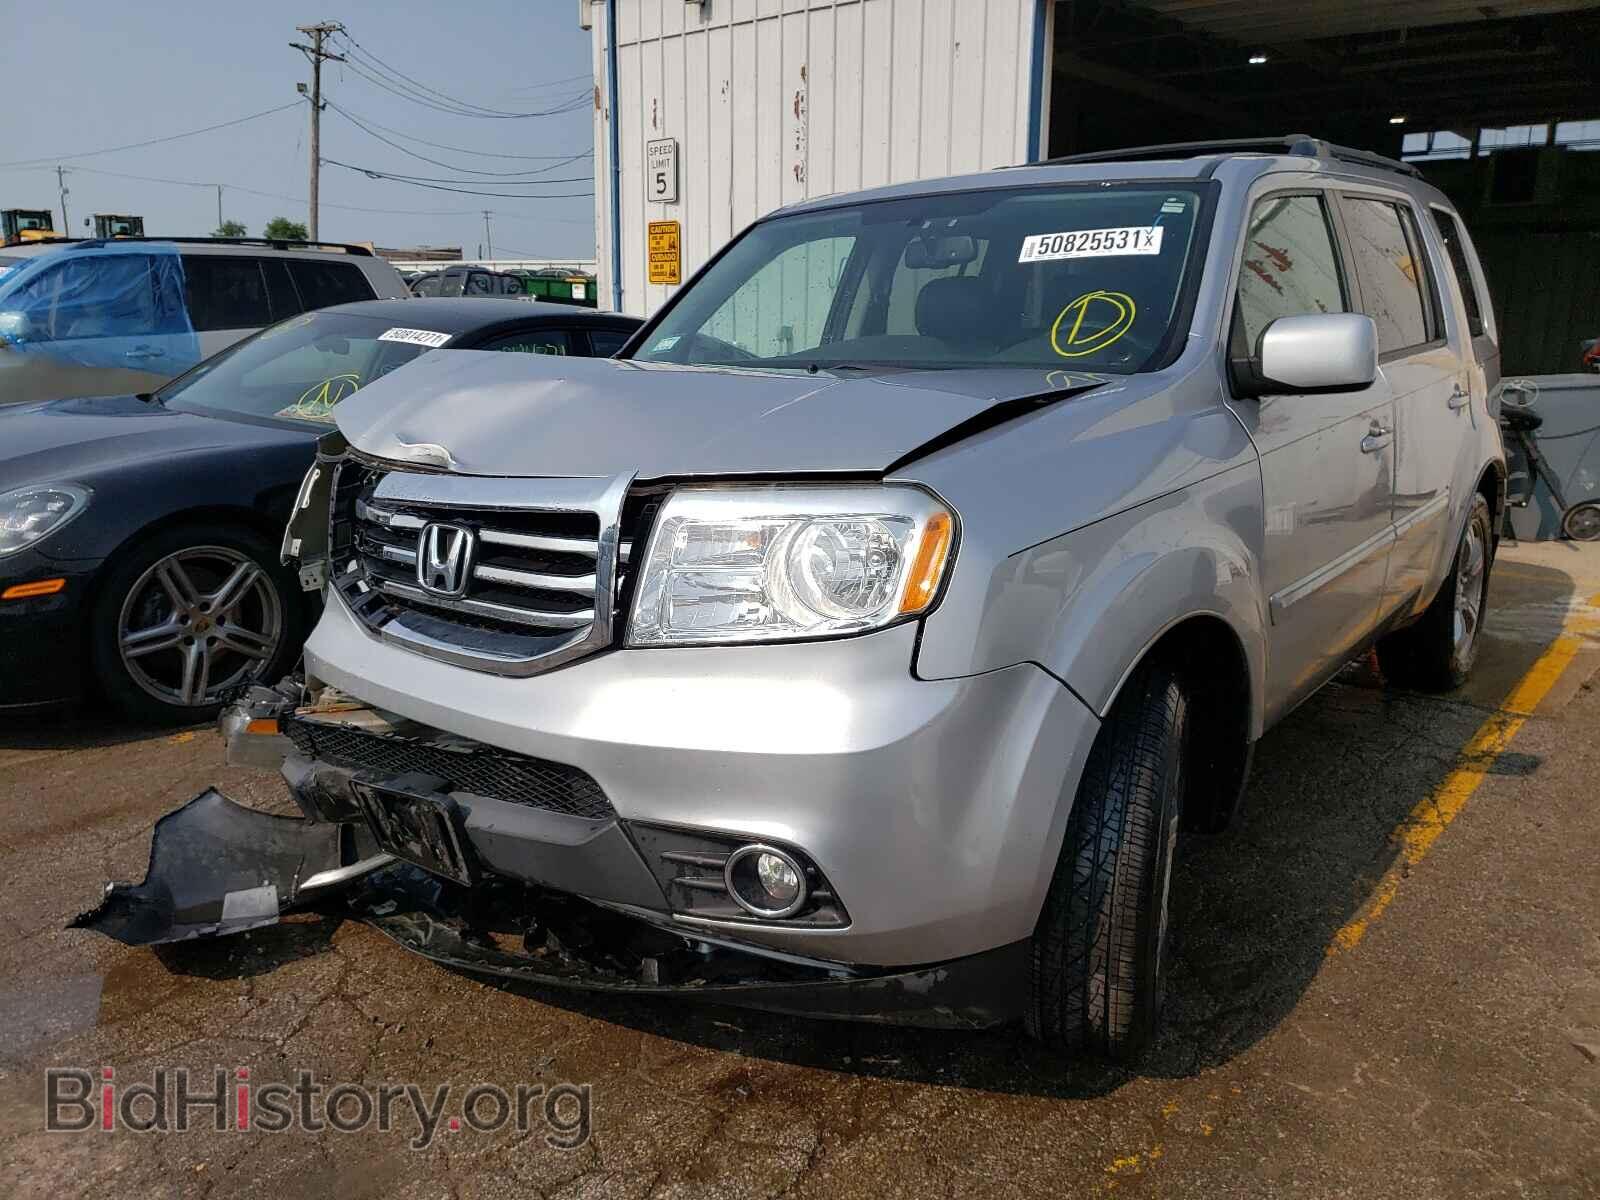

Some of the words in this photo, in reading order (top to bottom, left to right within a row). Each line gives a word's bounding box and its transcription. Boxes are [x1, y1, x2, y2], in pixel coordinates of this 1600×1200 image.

[649, 144, 673, 156] SPEED
[652, 158, 671, 169] LIMIT
[656, 172, 667, 195] 5
[650, 225, 676, 234] CAUTION
[1038, 230, 1141, 255] 50825531
